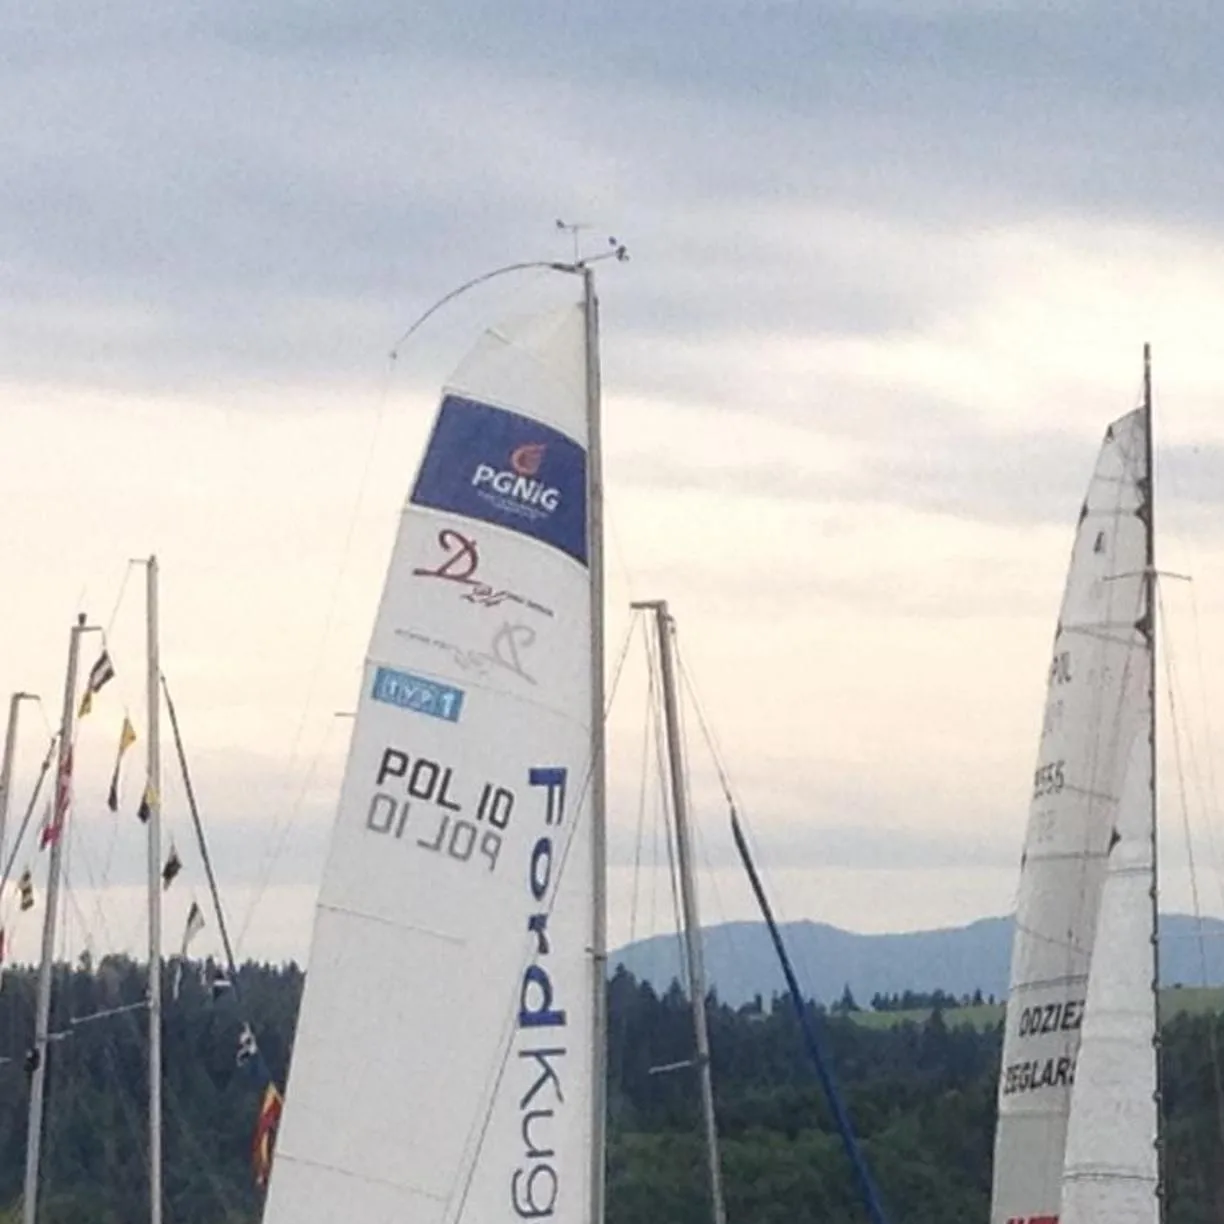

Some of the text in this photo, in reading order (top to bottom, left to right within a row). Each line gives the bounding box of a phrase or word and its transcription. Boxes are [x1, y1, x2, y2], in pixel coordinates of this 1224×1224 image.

[472, 464, 559, 511] PGNiG
[376, 748, 515, 830] POL 10
[518, 767, 569, 1028] Ford
